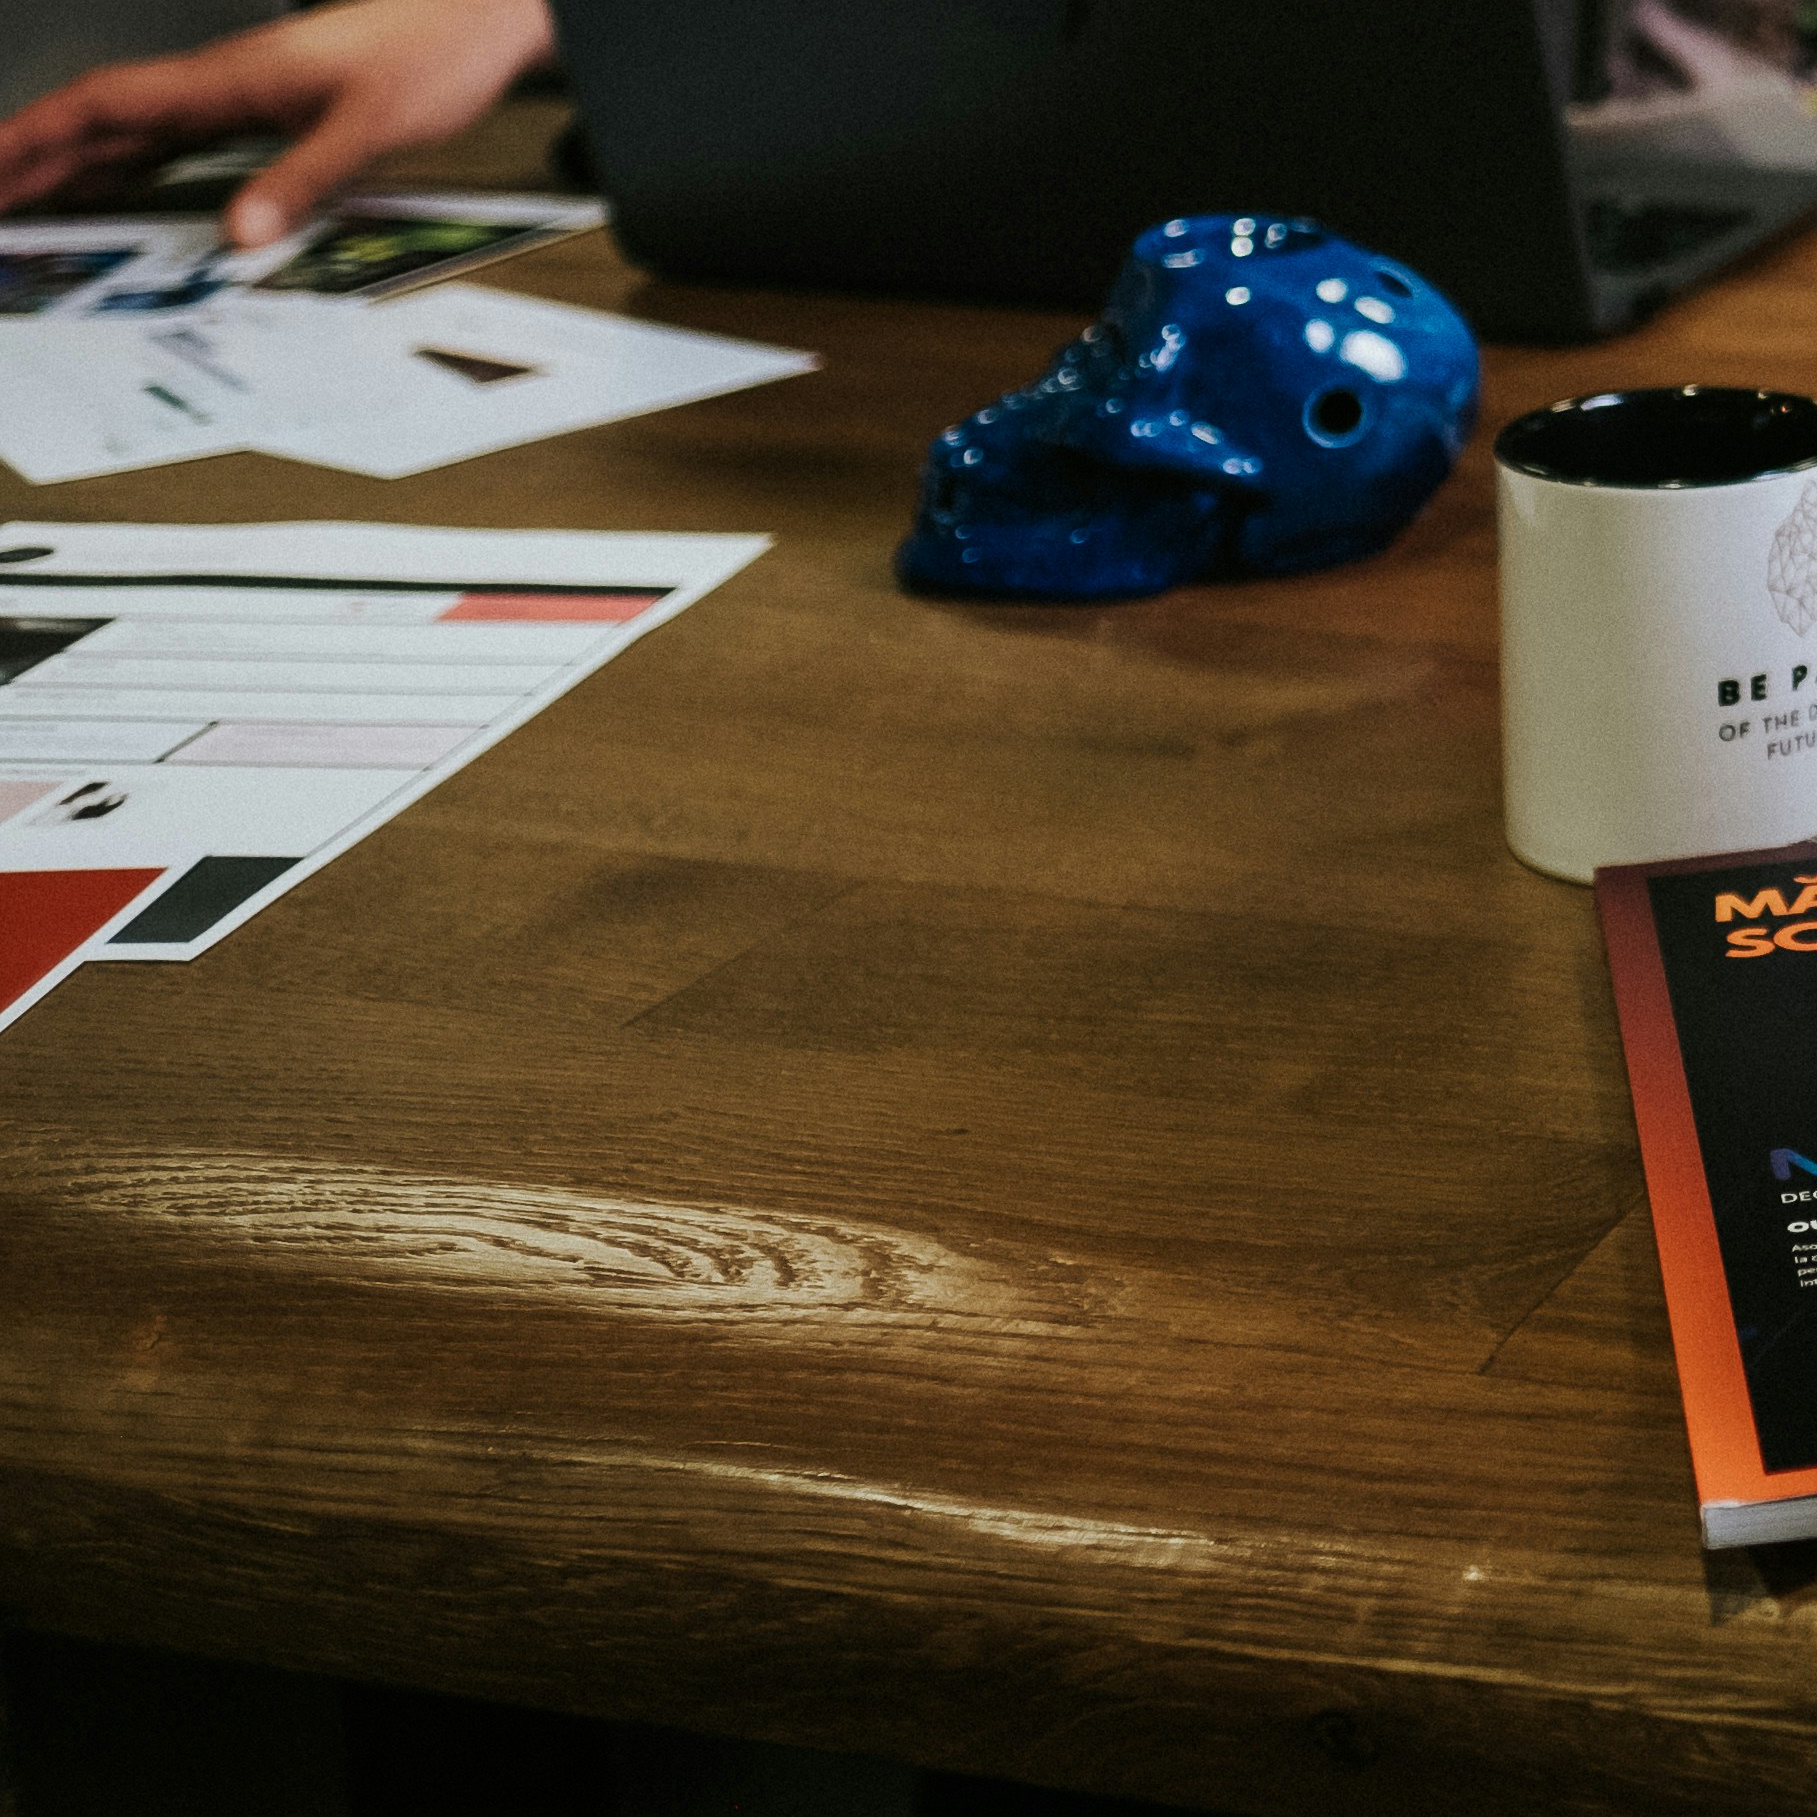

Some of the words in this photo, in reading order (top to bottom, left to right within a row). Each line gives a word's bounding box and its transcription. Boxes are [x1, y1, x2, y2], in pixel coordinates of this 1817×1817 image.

[1718, 674, 1767, 707] BE
[1718, 722, 1751, 742] OF
[1762, 709, 1800, 733] THE
